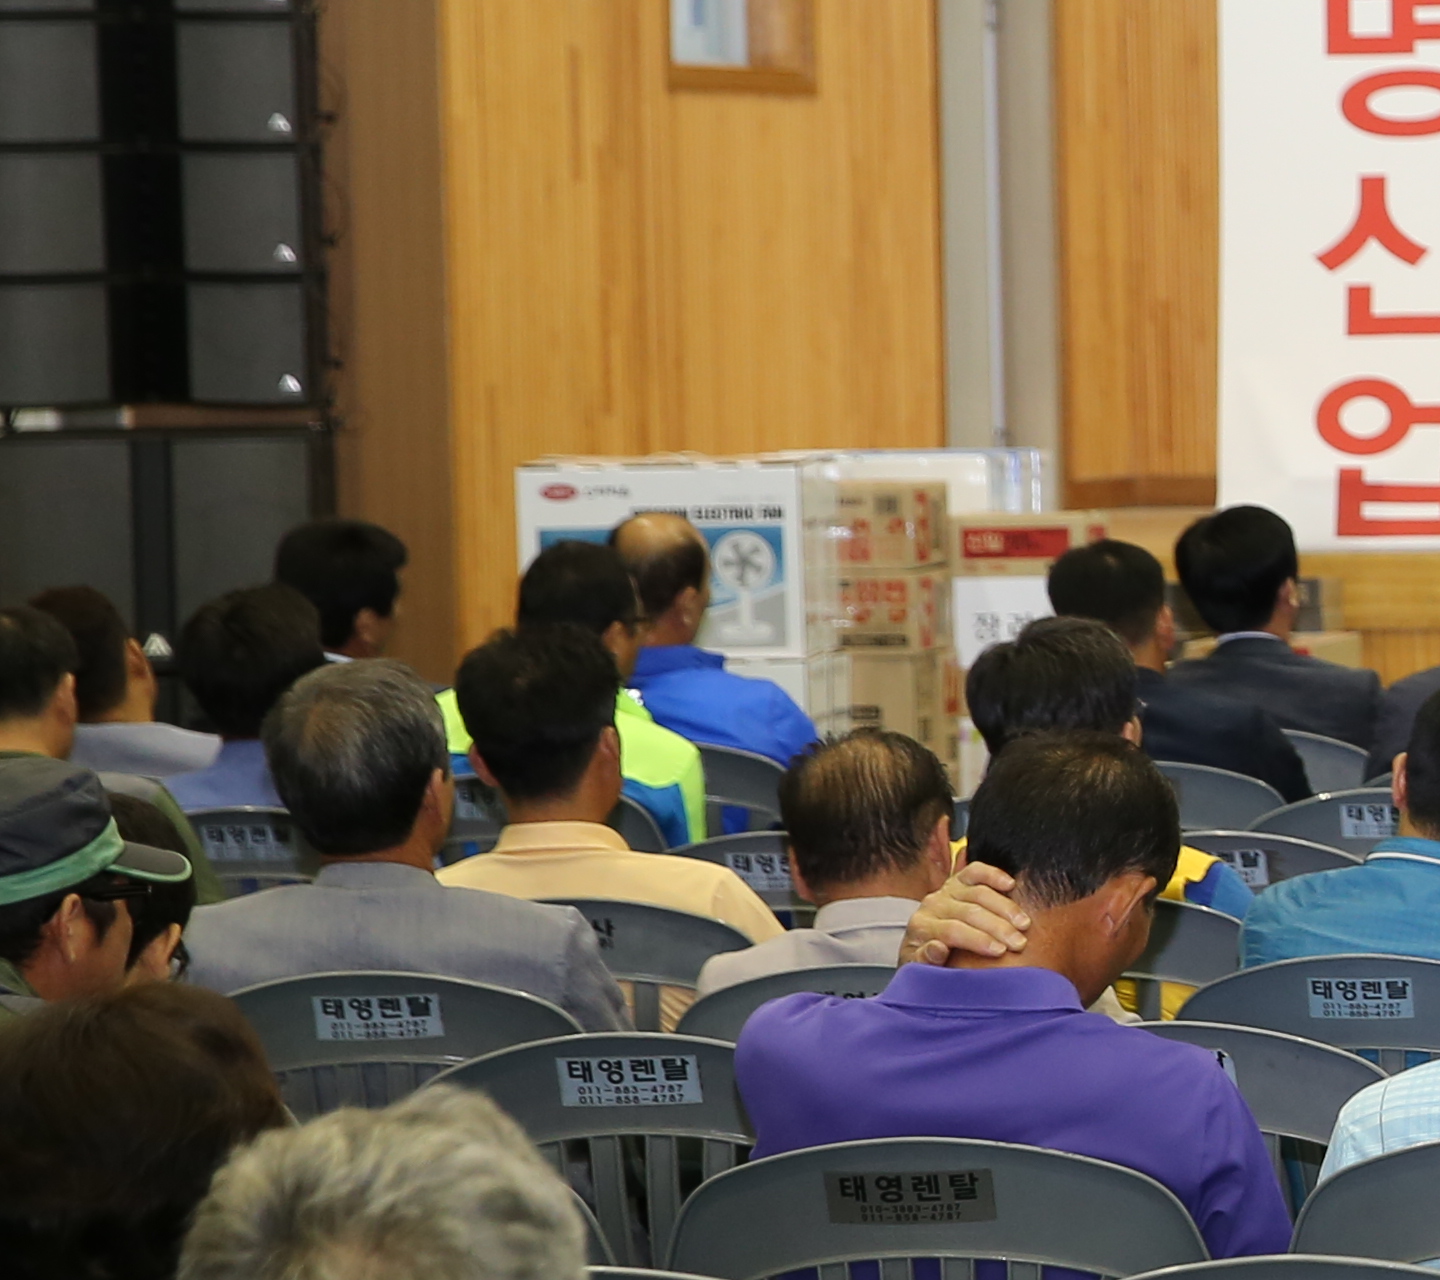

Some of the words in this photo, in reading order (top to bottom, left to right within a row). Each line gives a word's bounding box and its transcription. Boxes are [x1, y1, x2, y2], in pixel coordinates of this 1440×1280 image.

[1310, 976, 1411, 1001] 태영렌탈
[323, 995, 433, 1022] 태영렌탈
[566, 1058, 690, 1083] 태영렌탈
[837, 1172, 980, 1205] 태영렌탈
